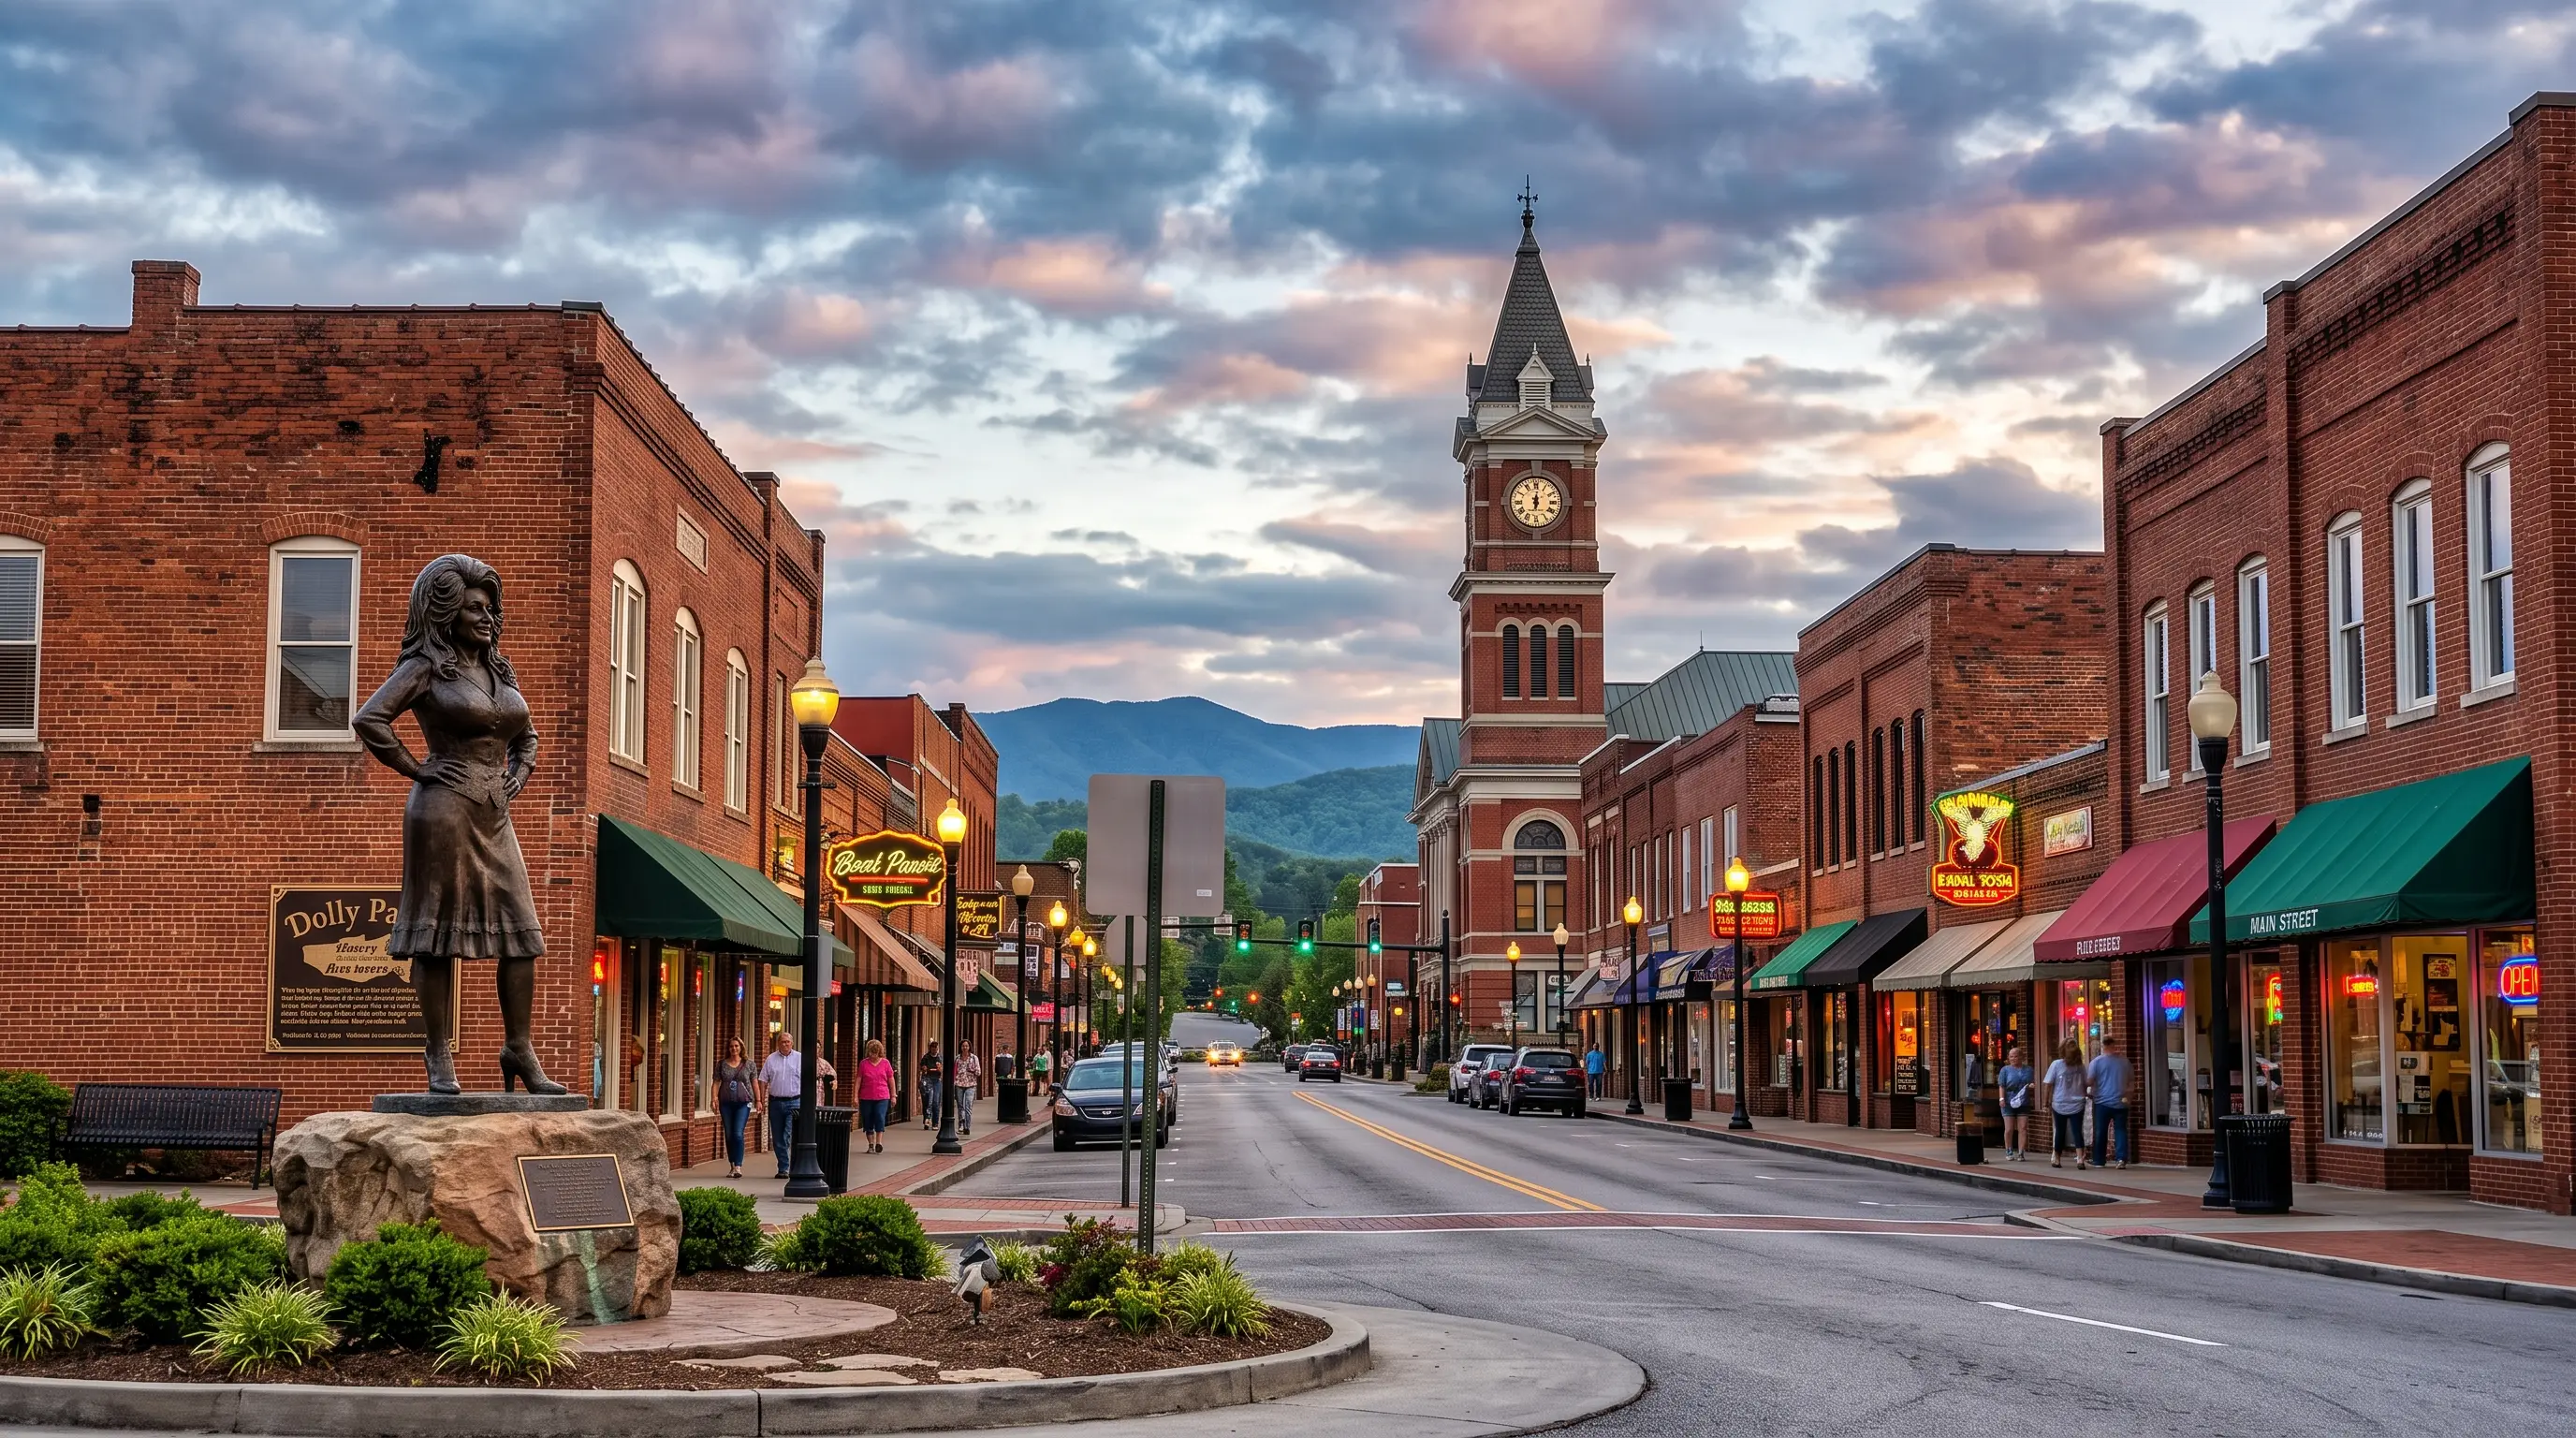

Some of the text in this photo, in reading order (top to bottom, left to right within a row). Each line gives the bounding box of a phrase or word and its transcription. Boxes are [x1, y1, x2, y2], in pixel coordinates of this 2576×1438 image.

[284, 898, 398, 939] Dolly Pa
[2250, 908, 2319, 934] MAIN STREET
